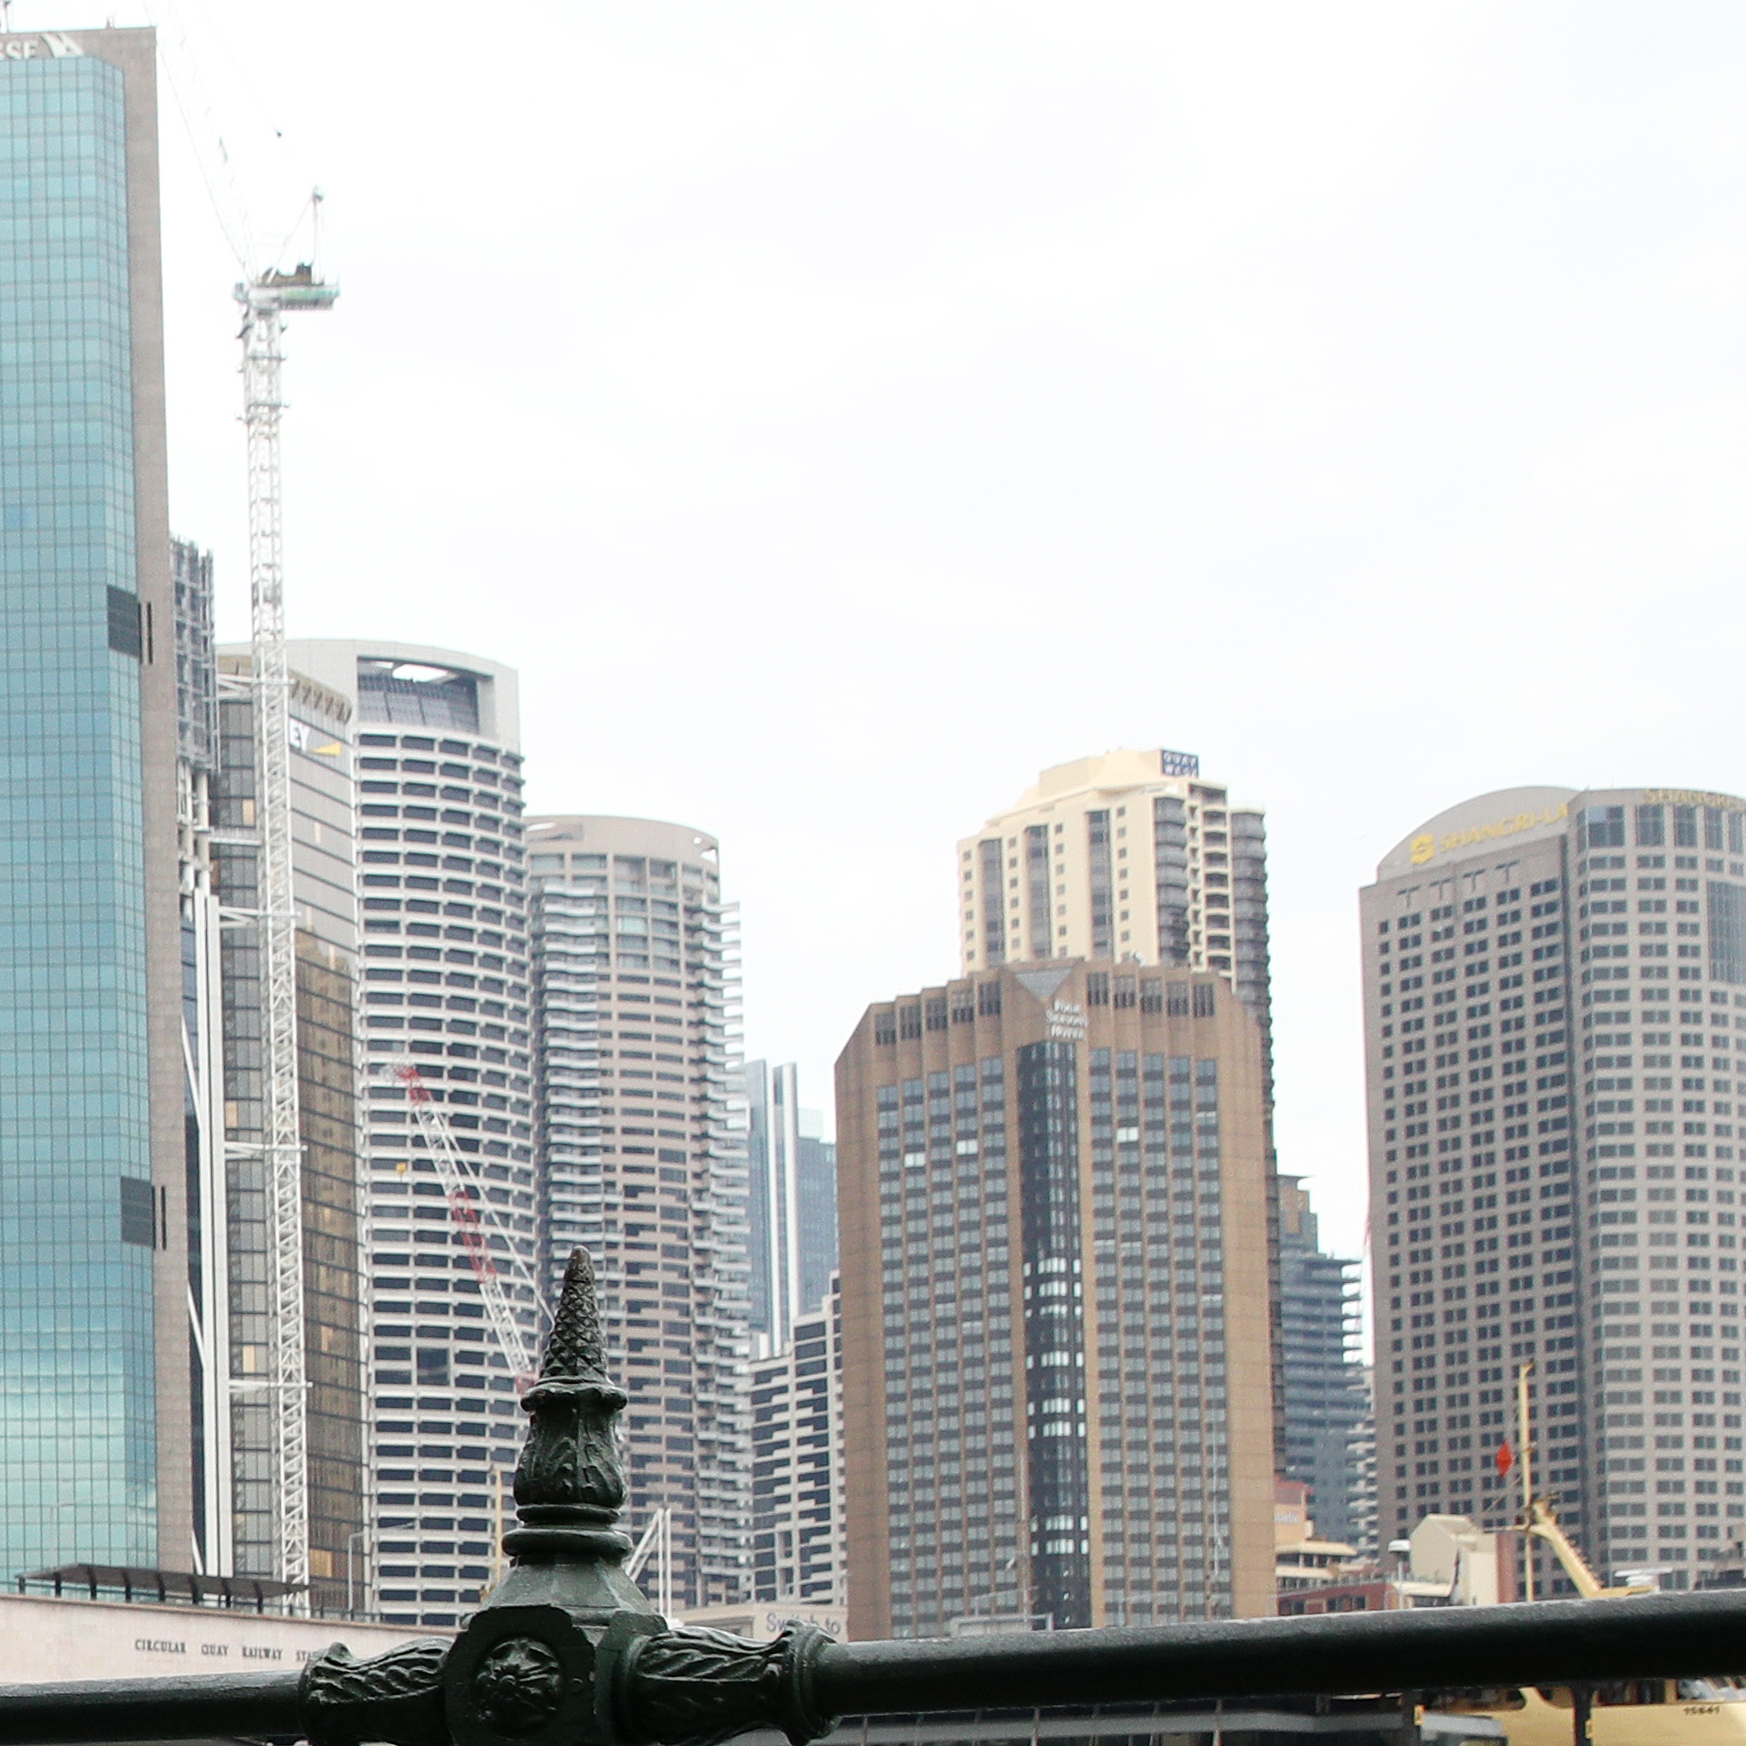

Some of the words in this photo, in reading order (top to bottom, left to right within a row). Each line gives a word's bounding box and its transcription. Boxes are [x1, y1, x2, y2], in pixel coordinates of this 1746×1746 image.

[289, 718, 311, 752] EY
[1163, 751, 1197, 767] QUAY
[1440, 803, 1569, 852] SHANGRI-LA
[825, 1616, 841, 1635] to
[134, 1639, 186, 1653] CIRCULAR
[201, 1643, 228, 1656] QUAY
[242, 1646, 282, 1660] RAILWAY
